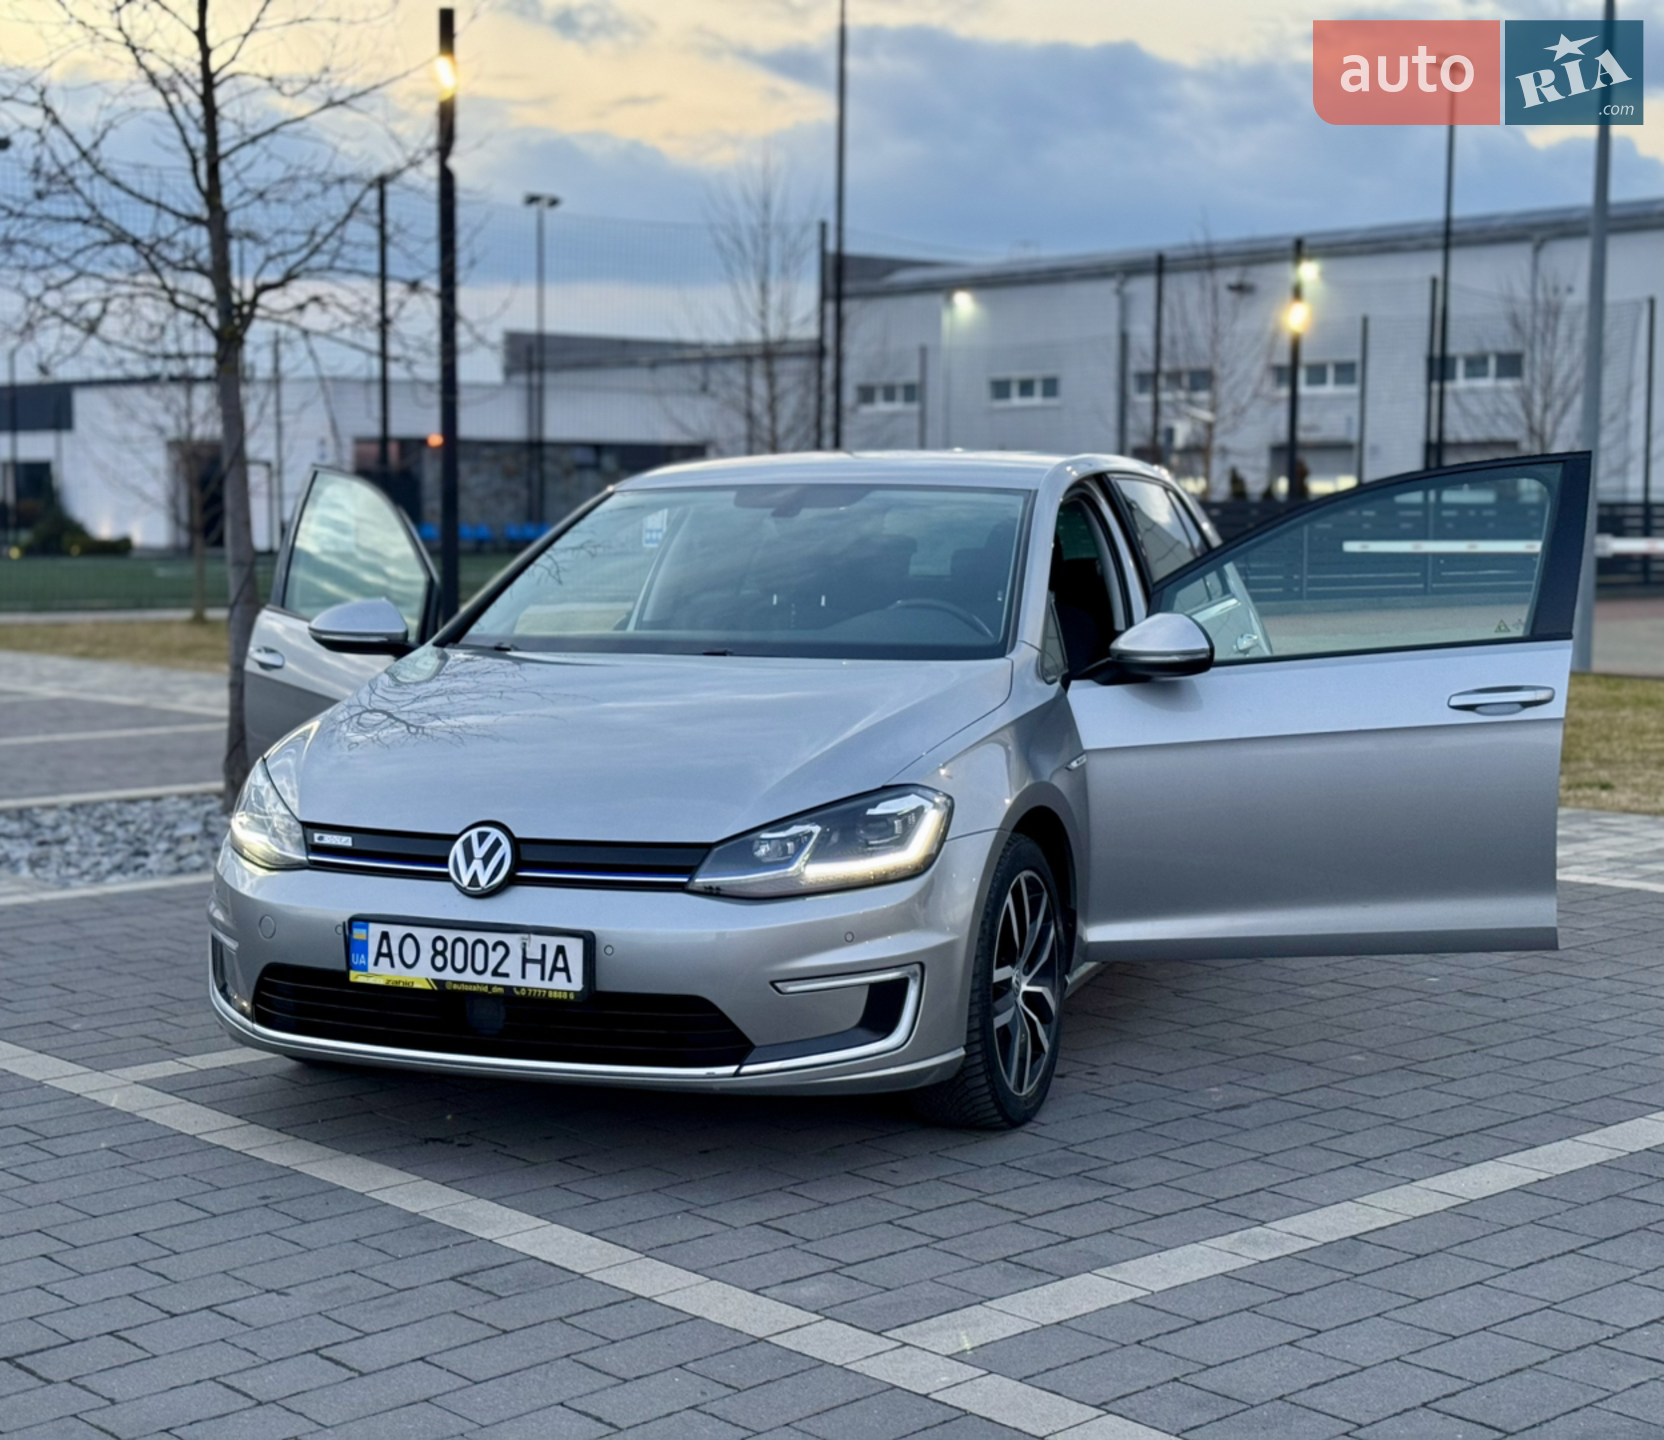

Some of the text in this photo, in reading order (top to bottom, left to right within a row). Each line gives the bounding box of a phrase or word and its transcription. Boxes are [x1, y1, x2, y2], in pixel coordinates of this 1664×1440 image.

[449, 826, 512, 891] VW
[352, 953, 366, 966] UA
[373, 930, 573, 984] AO 8002 HA
